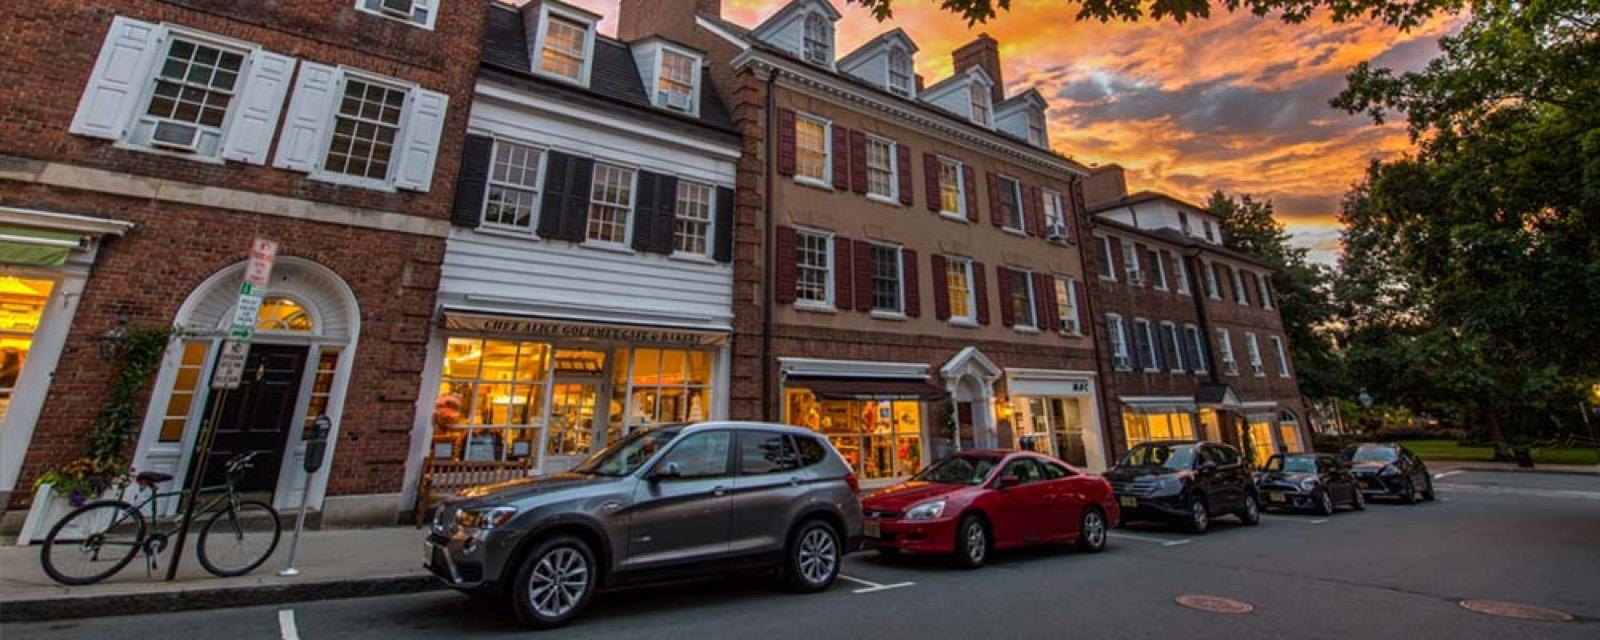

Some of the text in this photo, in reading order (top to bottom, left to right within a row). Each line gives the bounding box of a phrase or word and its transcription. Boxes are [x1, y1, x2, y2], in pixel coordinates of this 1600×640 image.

[484, 320, 519, 332] CHEZ
[522, 321, 558, 335] ALICE
[561, 325, 619, 338] GOURMET
